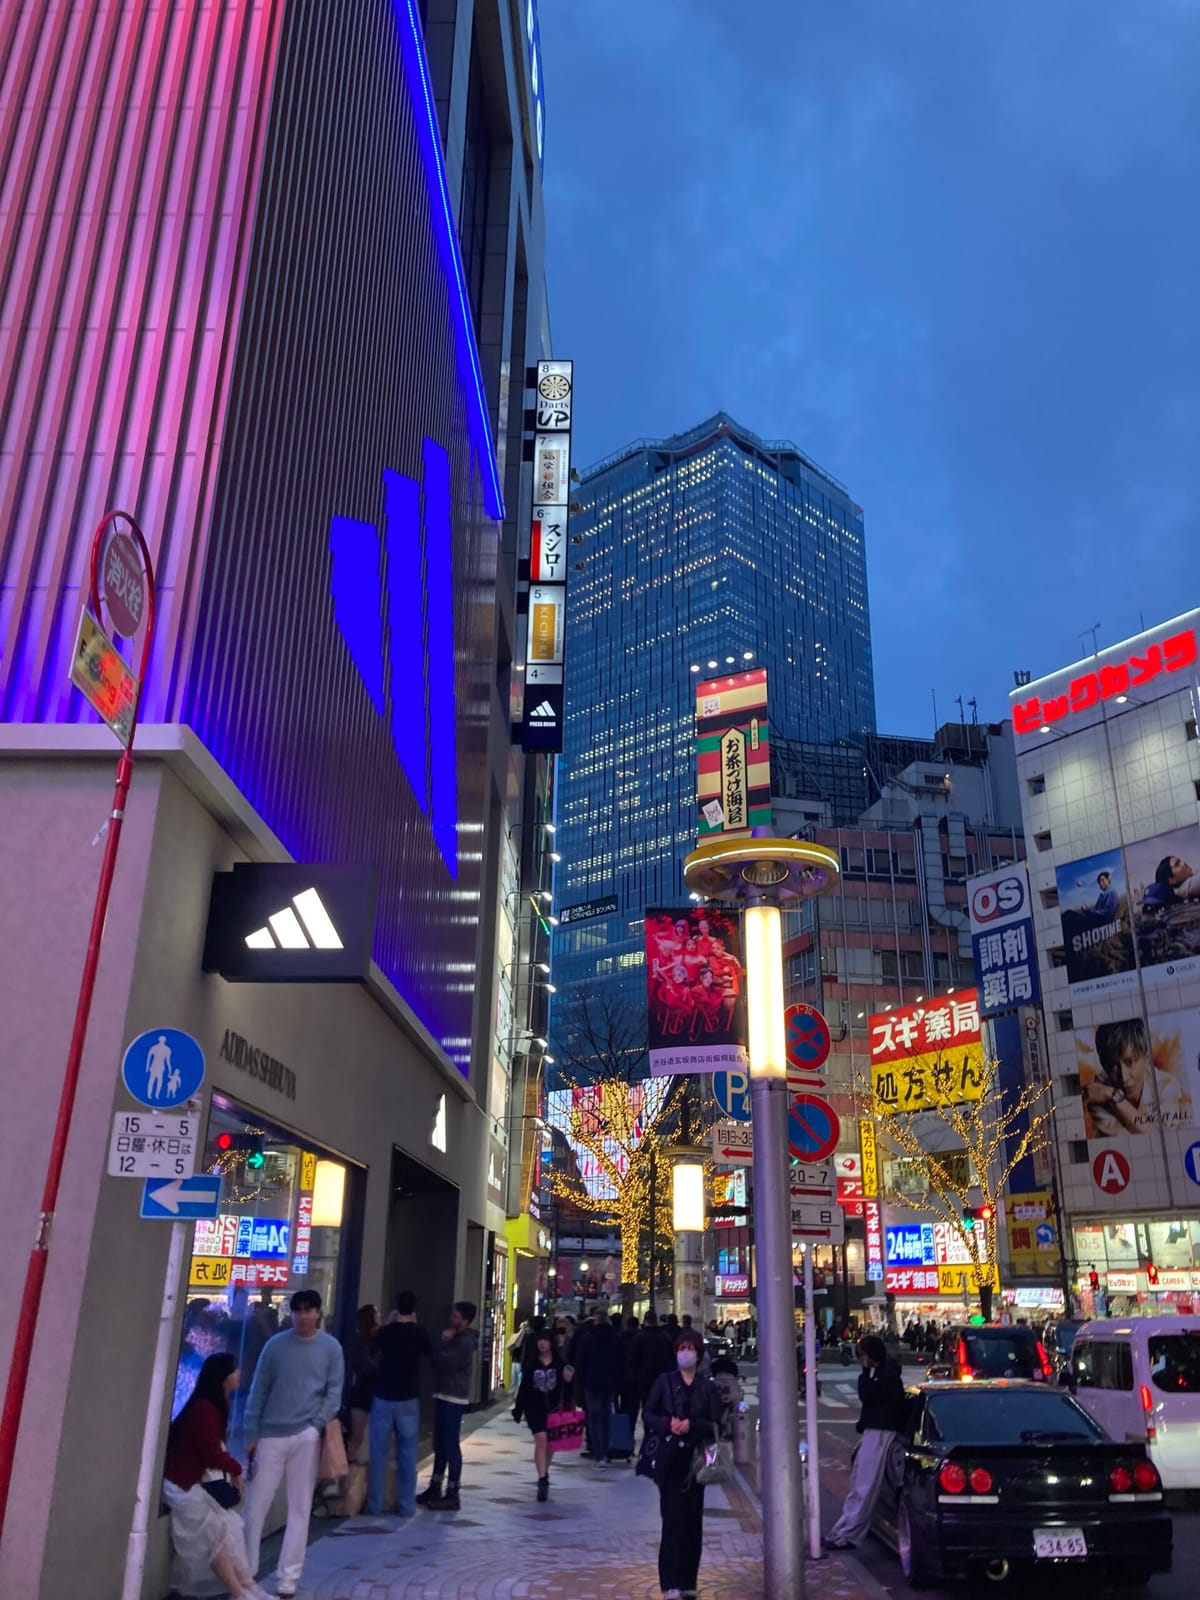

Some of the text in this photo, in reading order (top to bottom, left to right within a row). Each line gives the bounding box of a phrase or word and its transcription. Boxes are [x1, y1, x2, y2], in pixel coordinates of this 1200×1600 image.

[537, 410, 569, 427] UP
[540, 400, 569, 409] Darts
[544, 523, 562, 578] スシロー
[106, 547, 142, 623] 消火栓
[1012, 628, 1198, 735] ビックカメラ
[725, 738, 744, 825] お茶づけ海苔
[973, 876, 1025, 924] OS
[979, 925, 1028, 972] 調剤
[1072, 919, 1122, 953] SHOTIME
[982, 964, 1033, 1010] 薬局
[872, 1000, 980, 1055] スギ薬局
[726, 1071, 749, 1113] P
[875, 1056, 985, 1105] 処方せん
[123, 1117, 140, 1133] 15
[179, 1120, 189, 1137] 5
[119, 1156, 136, 1173] 12
[174, 1158, 185, 1175] 5
[1100, 1153, 1125, 1188] A
[866, 1202, 881, 1259] スギ薬局
[922, 1226, 935, 1262] 営業
[886, 1268, 939, 1290] スギ薬局
